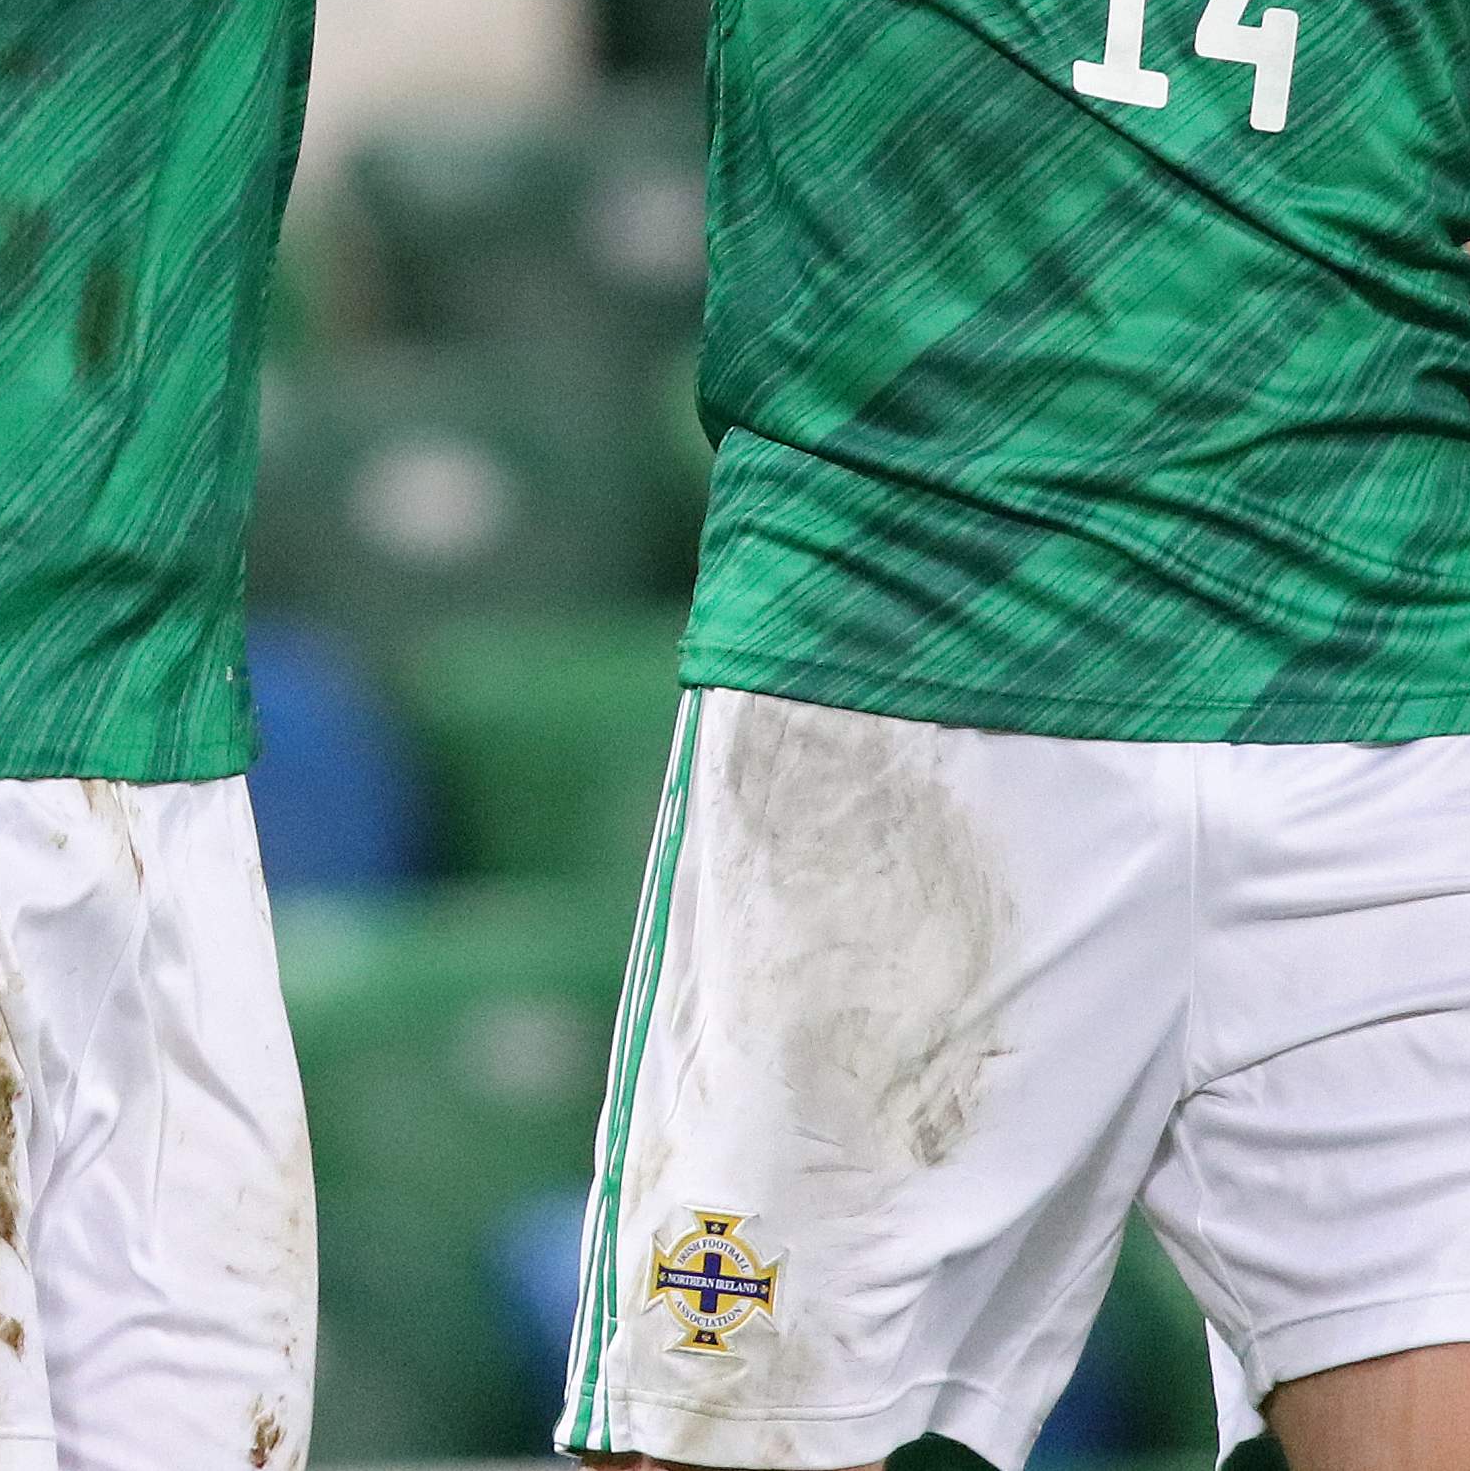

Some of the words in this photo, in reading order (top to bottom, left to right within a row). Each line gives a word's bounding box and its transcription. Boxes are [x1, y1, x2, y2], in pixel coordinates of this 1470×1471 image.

[677, 1241, 701, 1265] IRISH
[702, 1238, 750, 1274] FOOTBALL
[667, 1273, 715, 1289] NORTHERN
[715, 1278, 758, 1294] IRELAND
[675, 1299, 744, 1328] ASSOCIATION
